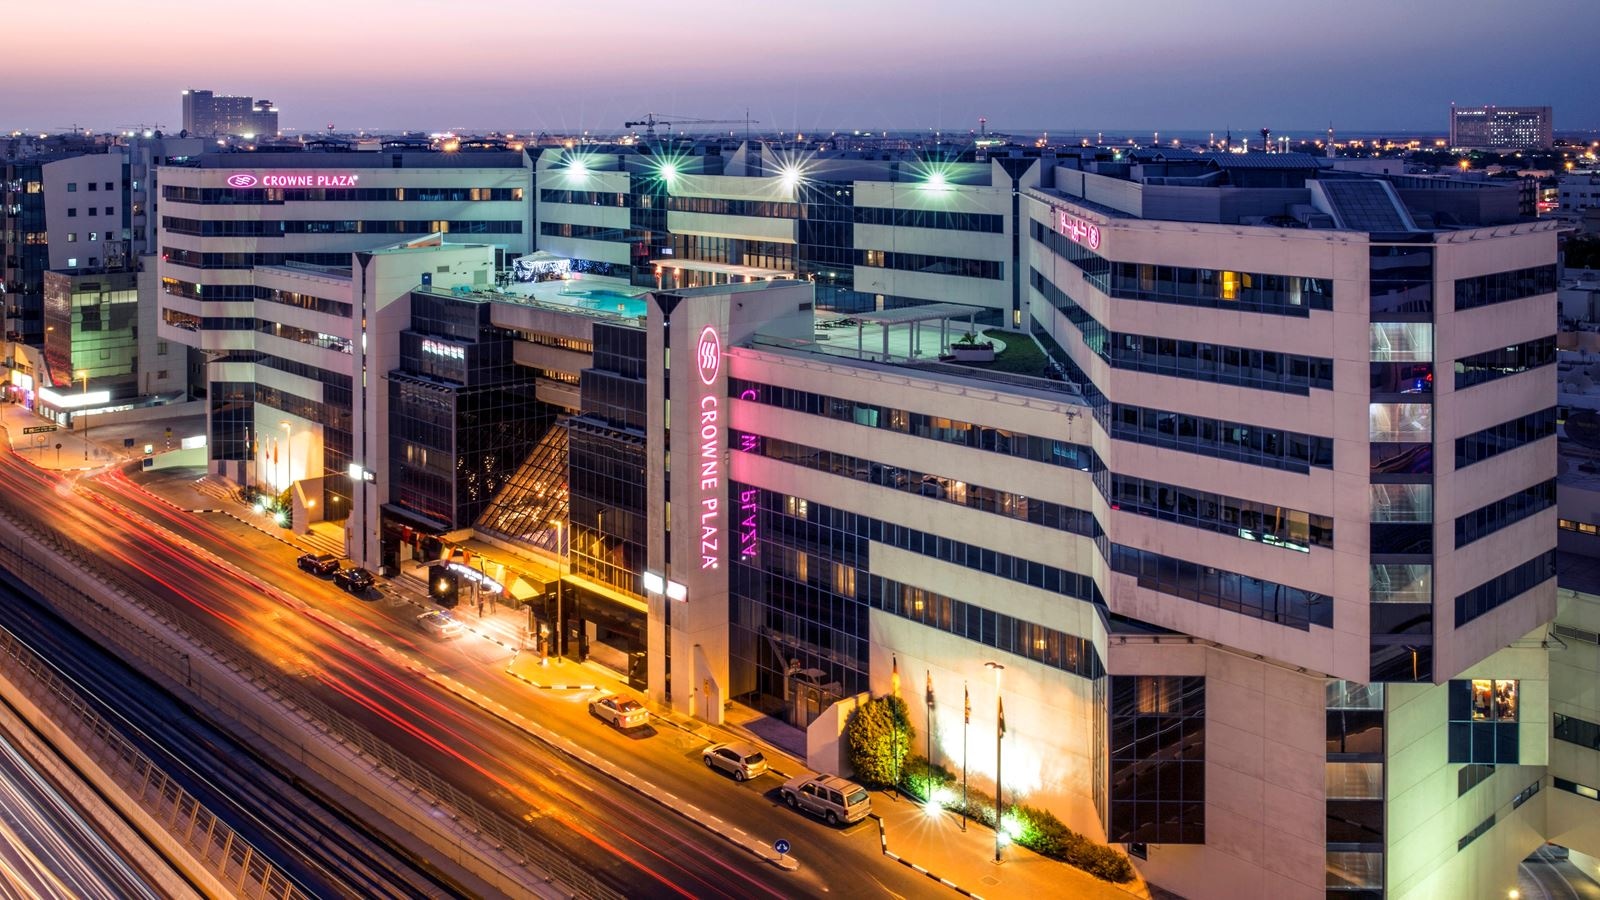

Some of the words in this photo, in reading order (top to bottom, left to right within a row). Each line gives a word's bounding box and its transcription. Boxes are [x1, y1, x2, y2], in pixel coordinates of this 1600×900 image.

[263, 175, 313, 186] CROWNE
[317, 175, 355, 186] PLAZA
[701, 395, 718, 490] CROWNE
[701, 498, 718, 569] PLAZA
